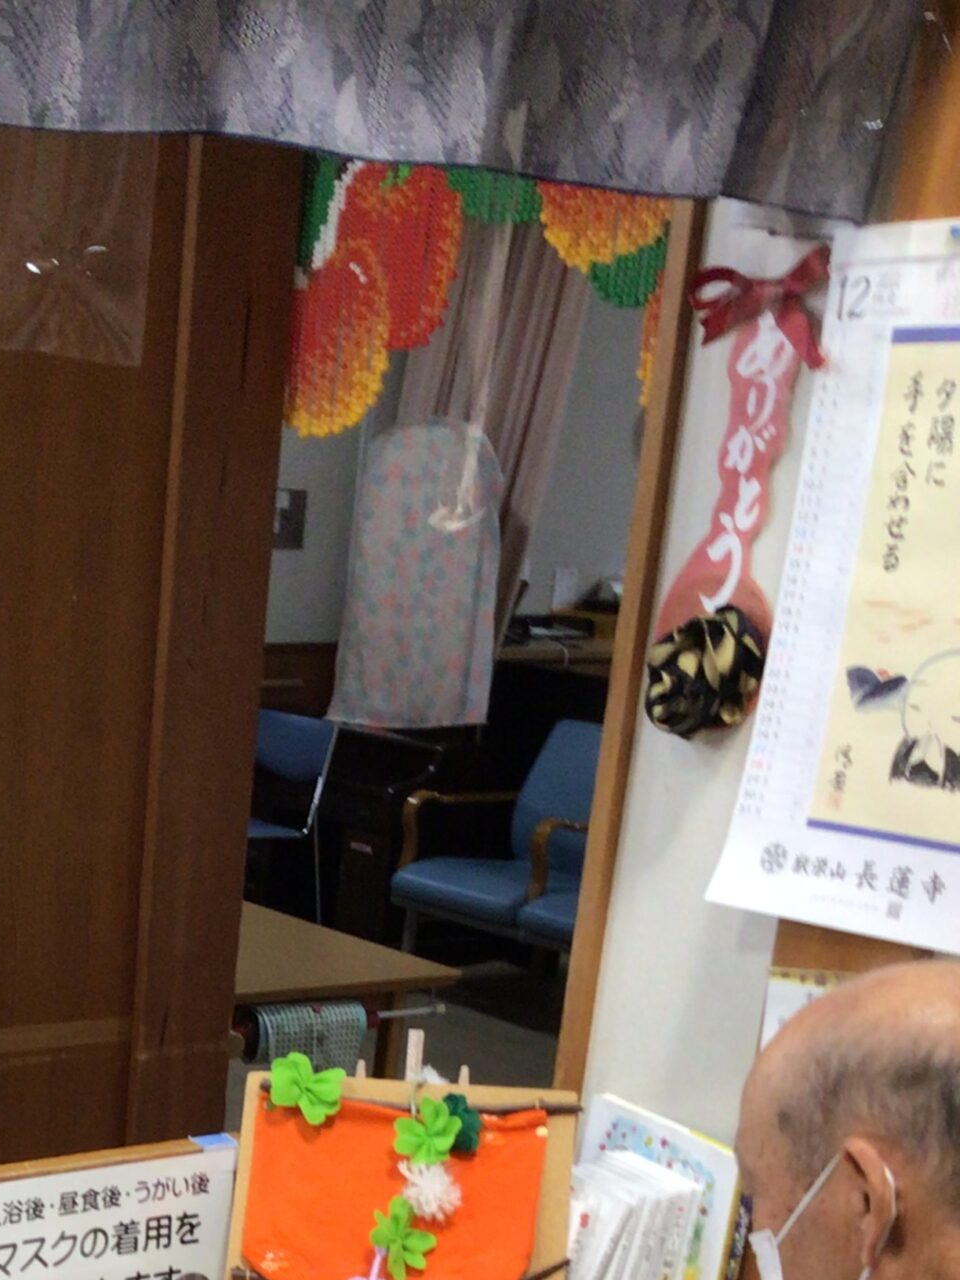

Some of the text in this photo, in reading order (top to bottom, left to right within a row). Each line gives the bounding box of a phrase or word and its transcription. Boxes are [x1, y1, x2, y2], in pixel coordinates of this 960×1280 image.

[836, 274, 872, 321] 12
[699, 309, 795, 613] ありがとう
